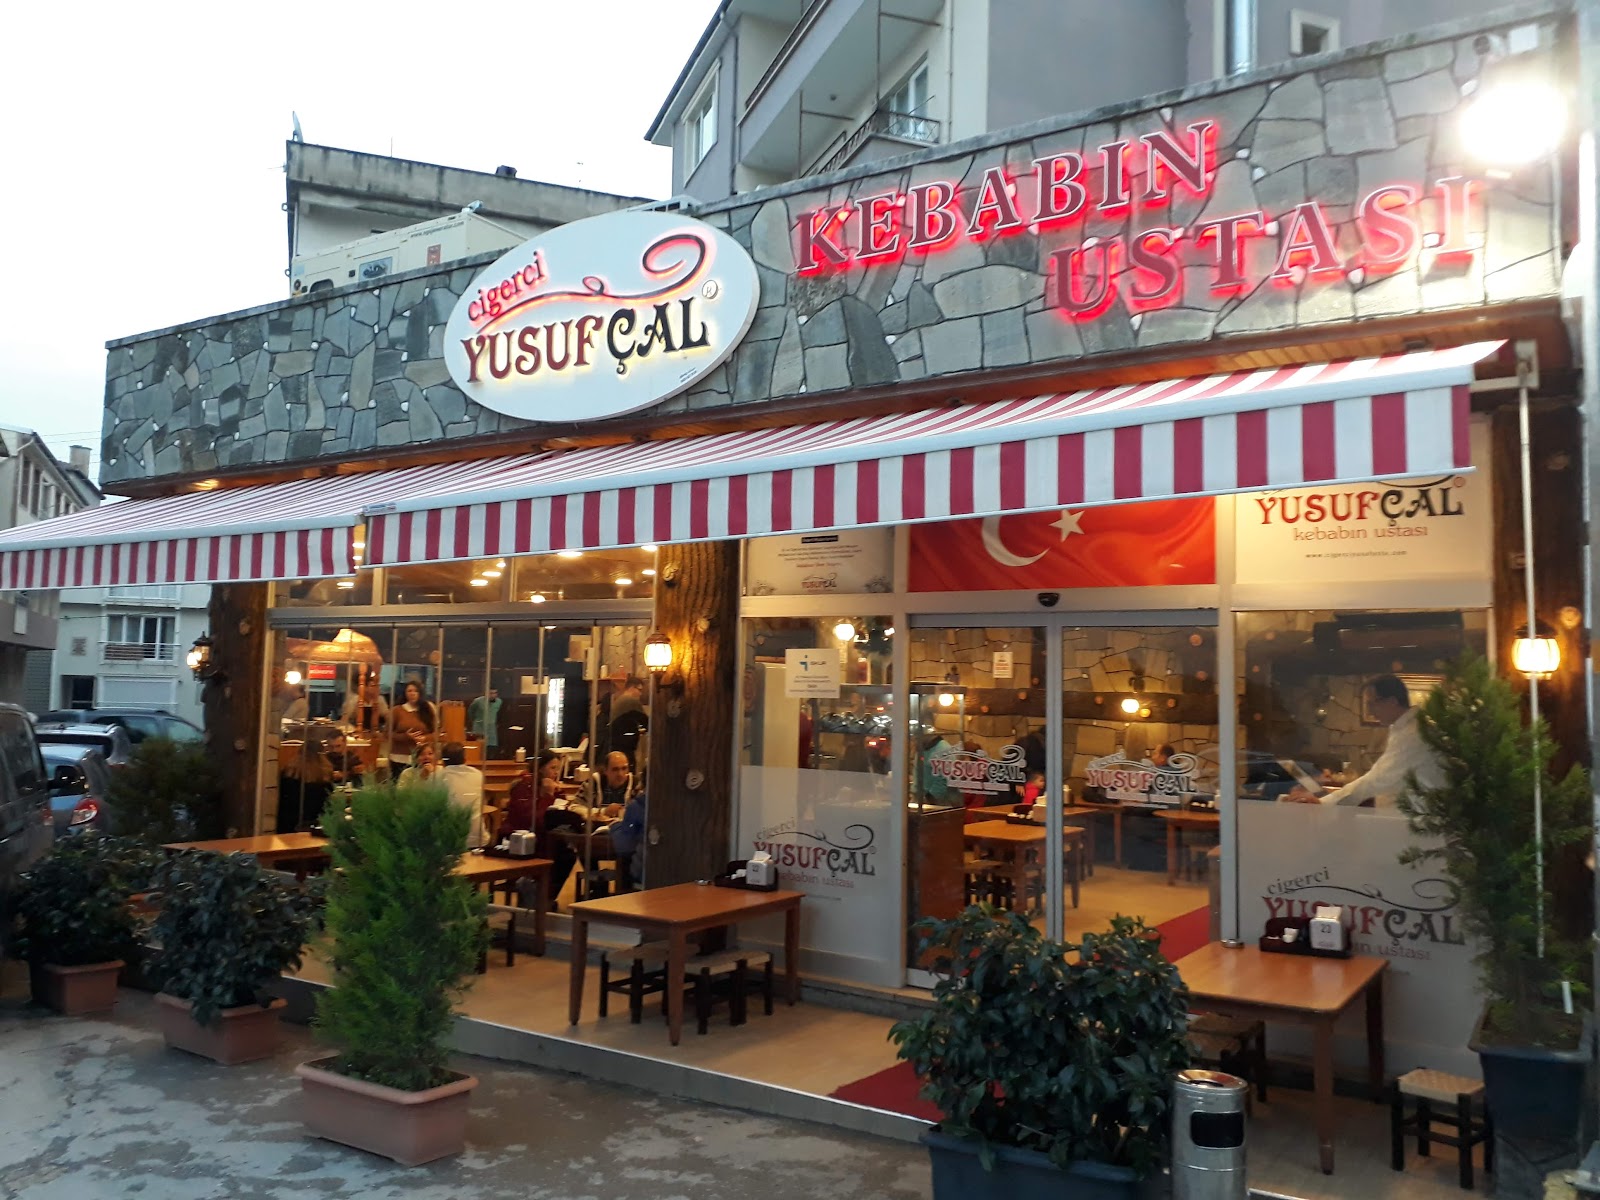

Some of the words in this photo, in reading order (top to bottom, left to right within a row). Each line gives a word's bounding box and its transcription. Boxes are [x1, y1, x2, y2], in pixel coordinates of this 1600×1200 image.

[796, 121, 1213, 272] KEBABIN
[1052, 173, 1480, 313] USTASI
[467, 249, 547, 321] cigerci
[461, 296, 711, 383] YUSUFÇAL
[1255, 486, 1464, 527] YUSUFÇAL
[1294, 527, 1368, 542] kebabın
[1374, 524, 1428, 538] ustası
[1267, 866, 1330, 895] cigerci
